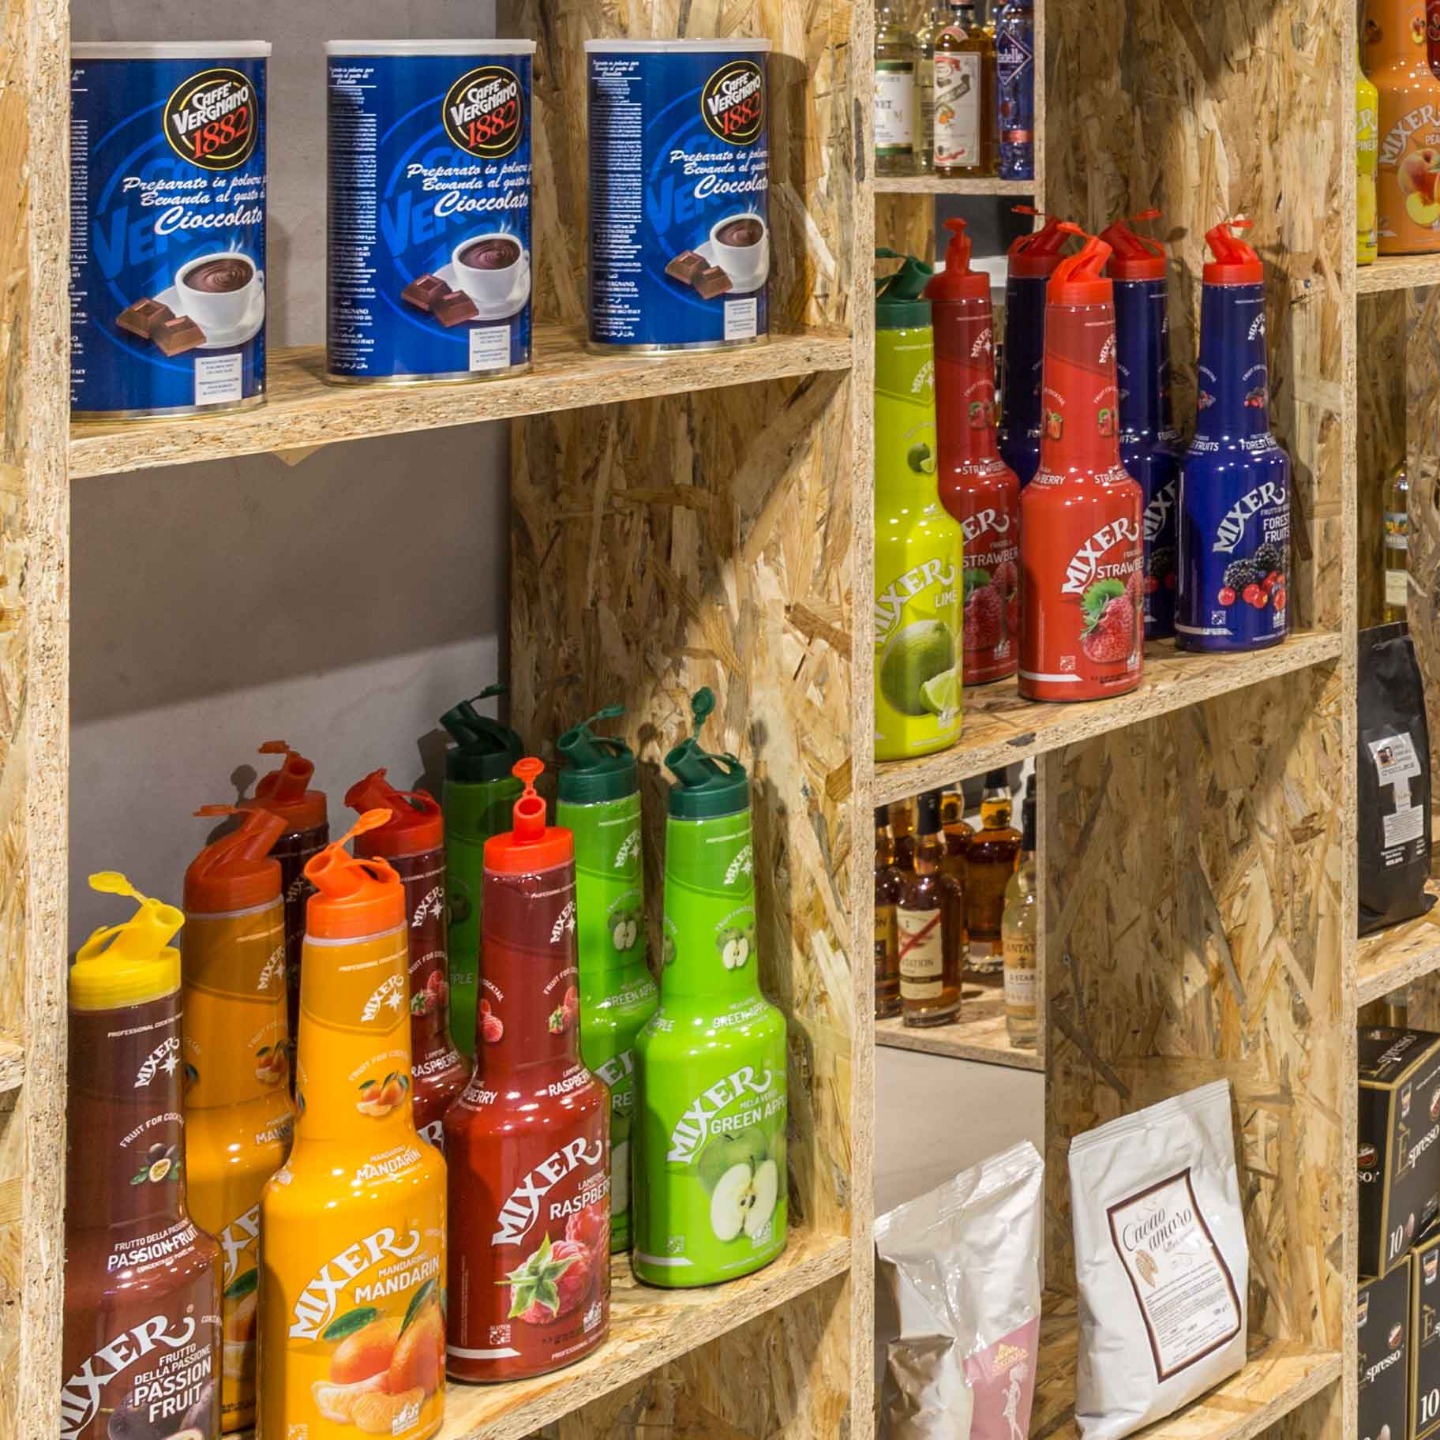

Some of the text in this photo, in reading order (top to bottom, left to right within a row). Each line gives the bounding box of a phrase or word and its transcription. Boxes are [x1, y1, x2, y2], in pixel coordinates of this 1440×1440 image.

[172, 84, 249, 135] VERGNANO
[450, 82, 517, 126] VERGNANO
[706, 75, 761, 116] VERGNANO
[722, 92, 761, 135] 1882
[192, 106, 249, 159] 1882
[467, 100, 517, 148] 1882
[407, 163, 481, 179] Preparato
[485, 163, 497, 174] in
[670, 149, 746, 164] Preparato in
[683, 159, 749, 175] Bevanda al
[122, 176, 207, 195] Preparato
[212, 176, 227, 188] in
[140, 187, 258, 207] Bevanda al gusto
[422, 177, 484, 191] Bevanda
[487, 175, 500, 188] al
[434, 190, 529, 217] Cioccolato
[153, 205, 263, 236] Cioccolato
[1212, 478, 1286, 555] MIXER
[1061, 516, 1140, 595] MIXER
[934, 588, 958, 609] LIME
[550, 900, 576, 944] MIXER
[360, 973, 405, 1023] MIXER
[543, 977, 560, 995] FRUIT
[106, 1023, 155, 1039] PROFESSIONAL
[133, 1036, 181, 1089] MIXER
[119, 1114, 163, 1149] FRUIT FOR
[666, 1065, 772, 1164] MIXER
[710, 1105, 763, 1134] GREEN
[355, 1147, 422, 1183] MANDARIN
[491, 1136, 603, 1246] MIXER
[106, 1223, 200, 1271] PASSION FRUIT
[113, 1236, 147, 1252] FRUTTO
[146, 1229, 168, 1244] DELLA
[1122, 1206, 1168, 1253] Cacao
[1148, 1208, 1192, 1252] amaro
[1389, 1224, 1404, 1261] 10
[288, 1227, 421, 1341] MIXER
[355, 1254, 440, 1305] MANDARIN
[134, 1344, 212, 1386] DELLA PASSIONE
[159, 1343, 197, 1367] FRUTTO
[133, 1356, 212, 1407] PASSION
[148, 1383, 203, 1423] FRUIT
[1420, 1387, 1440, 1426] 10
